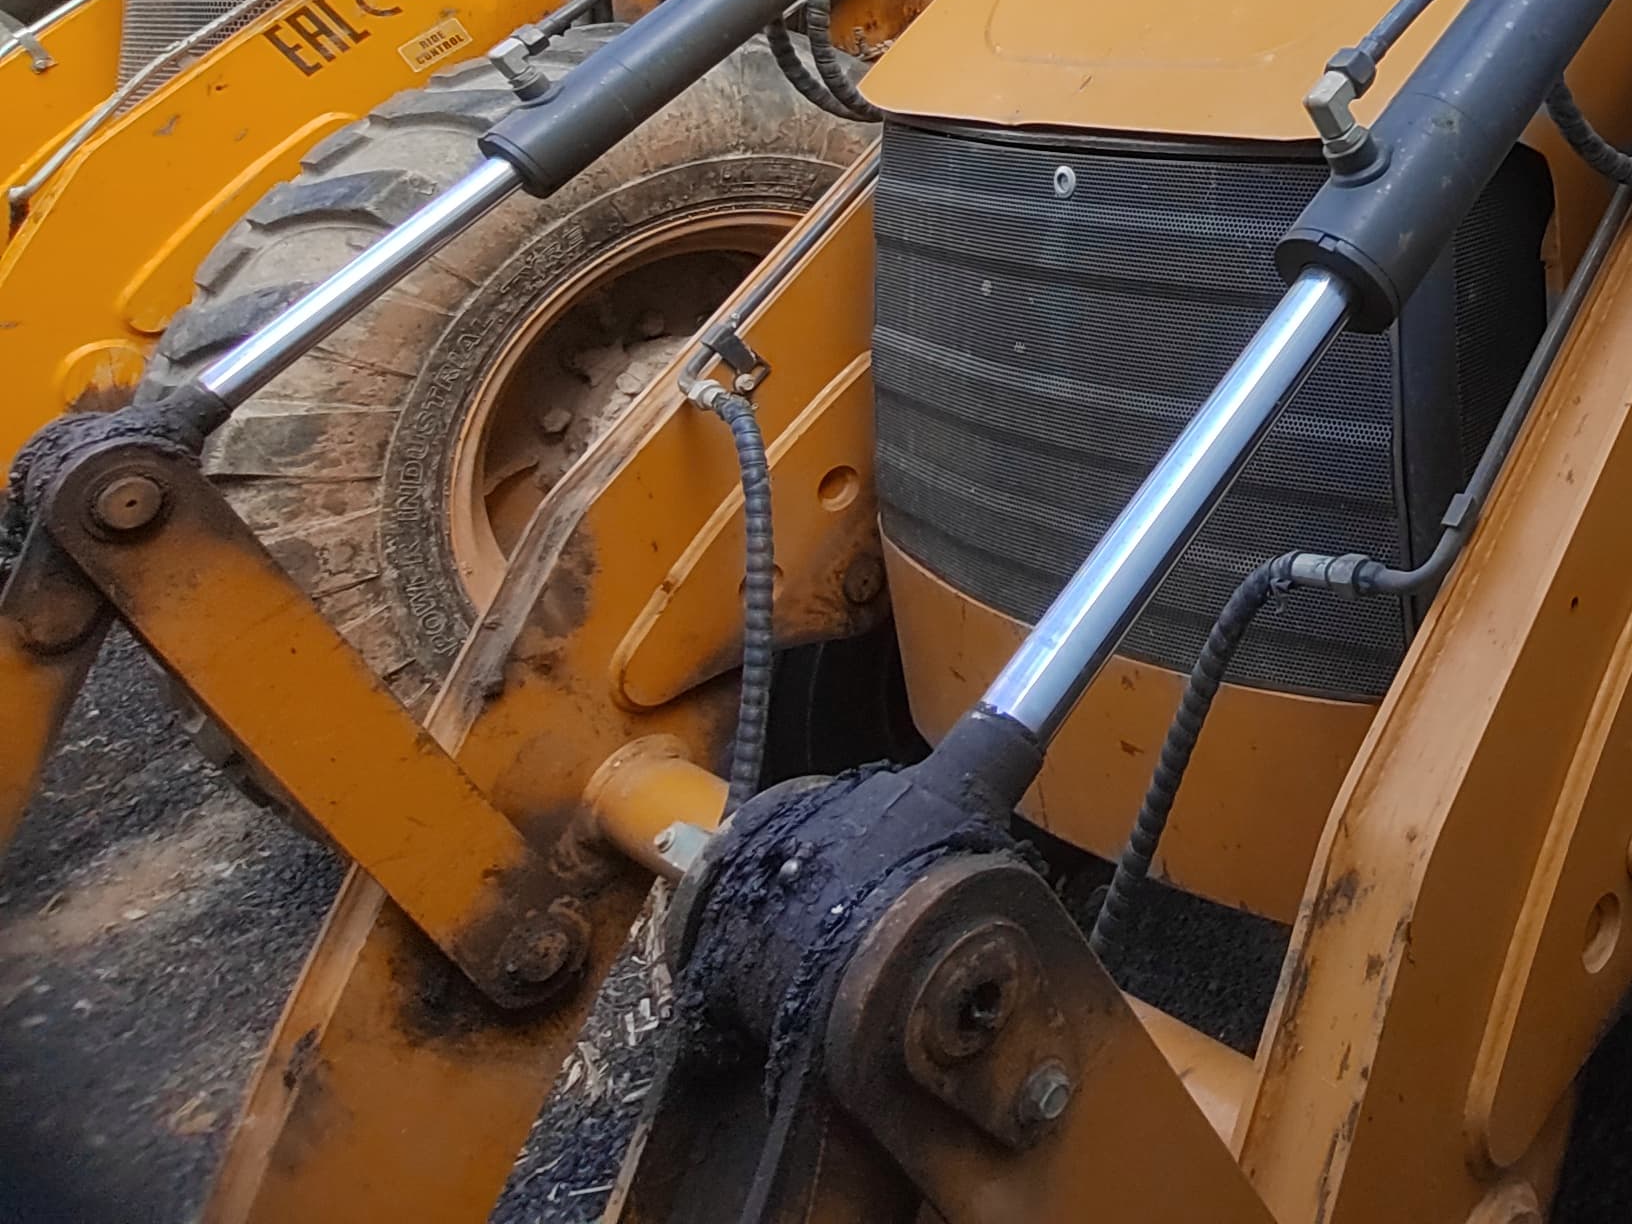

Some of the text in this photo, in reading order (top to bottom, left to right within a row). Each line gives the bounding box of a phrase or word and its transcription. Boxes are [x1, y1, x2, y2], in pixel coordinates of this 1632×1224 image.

[416, 34, 465, 65] CONTROL
[418, 30, 448, 49] RIDE
[396, 312, 498, 522] INDUSTRIAL
